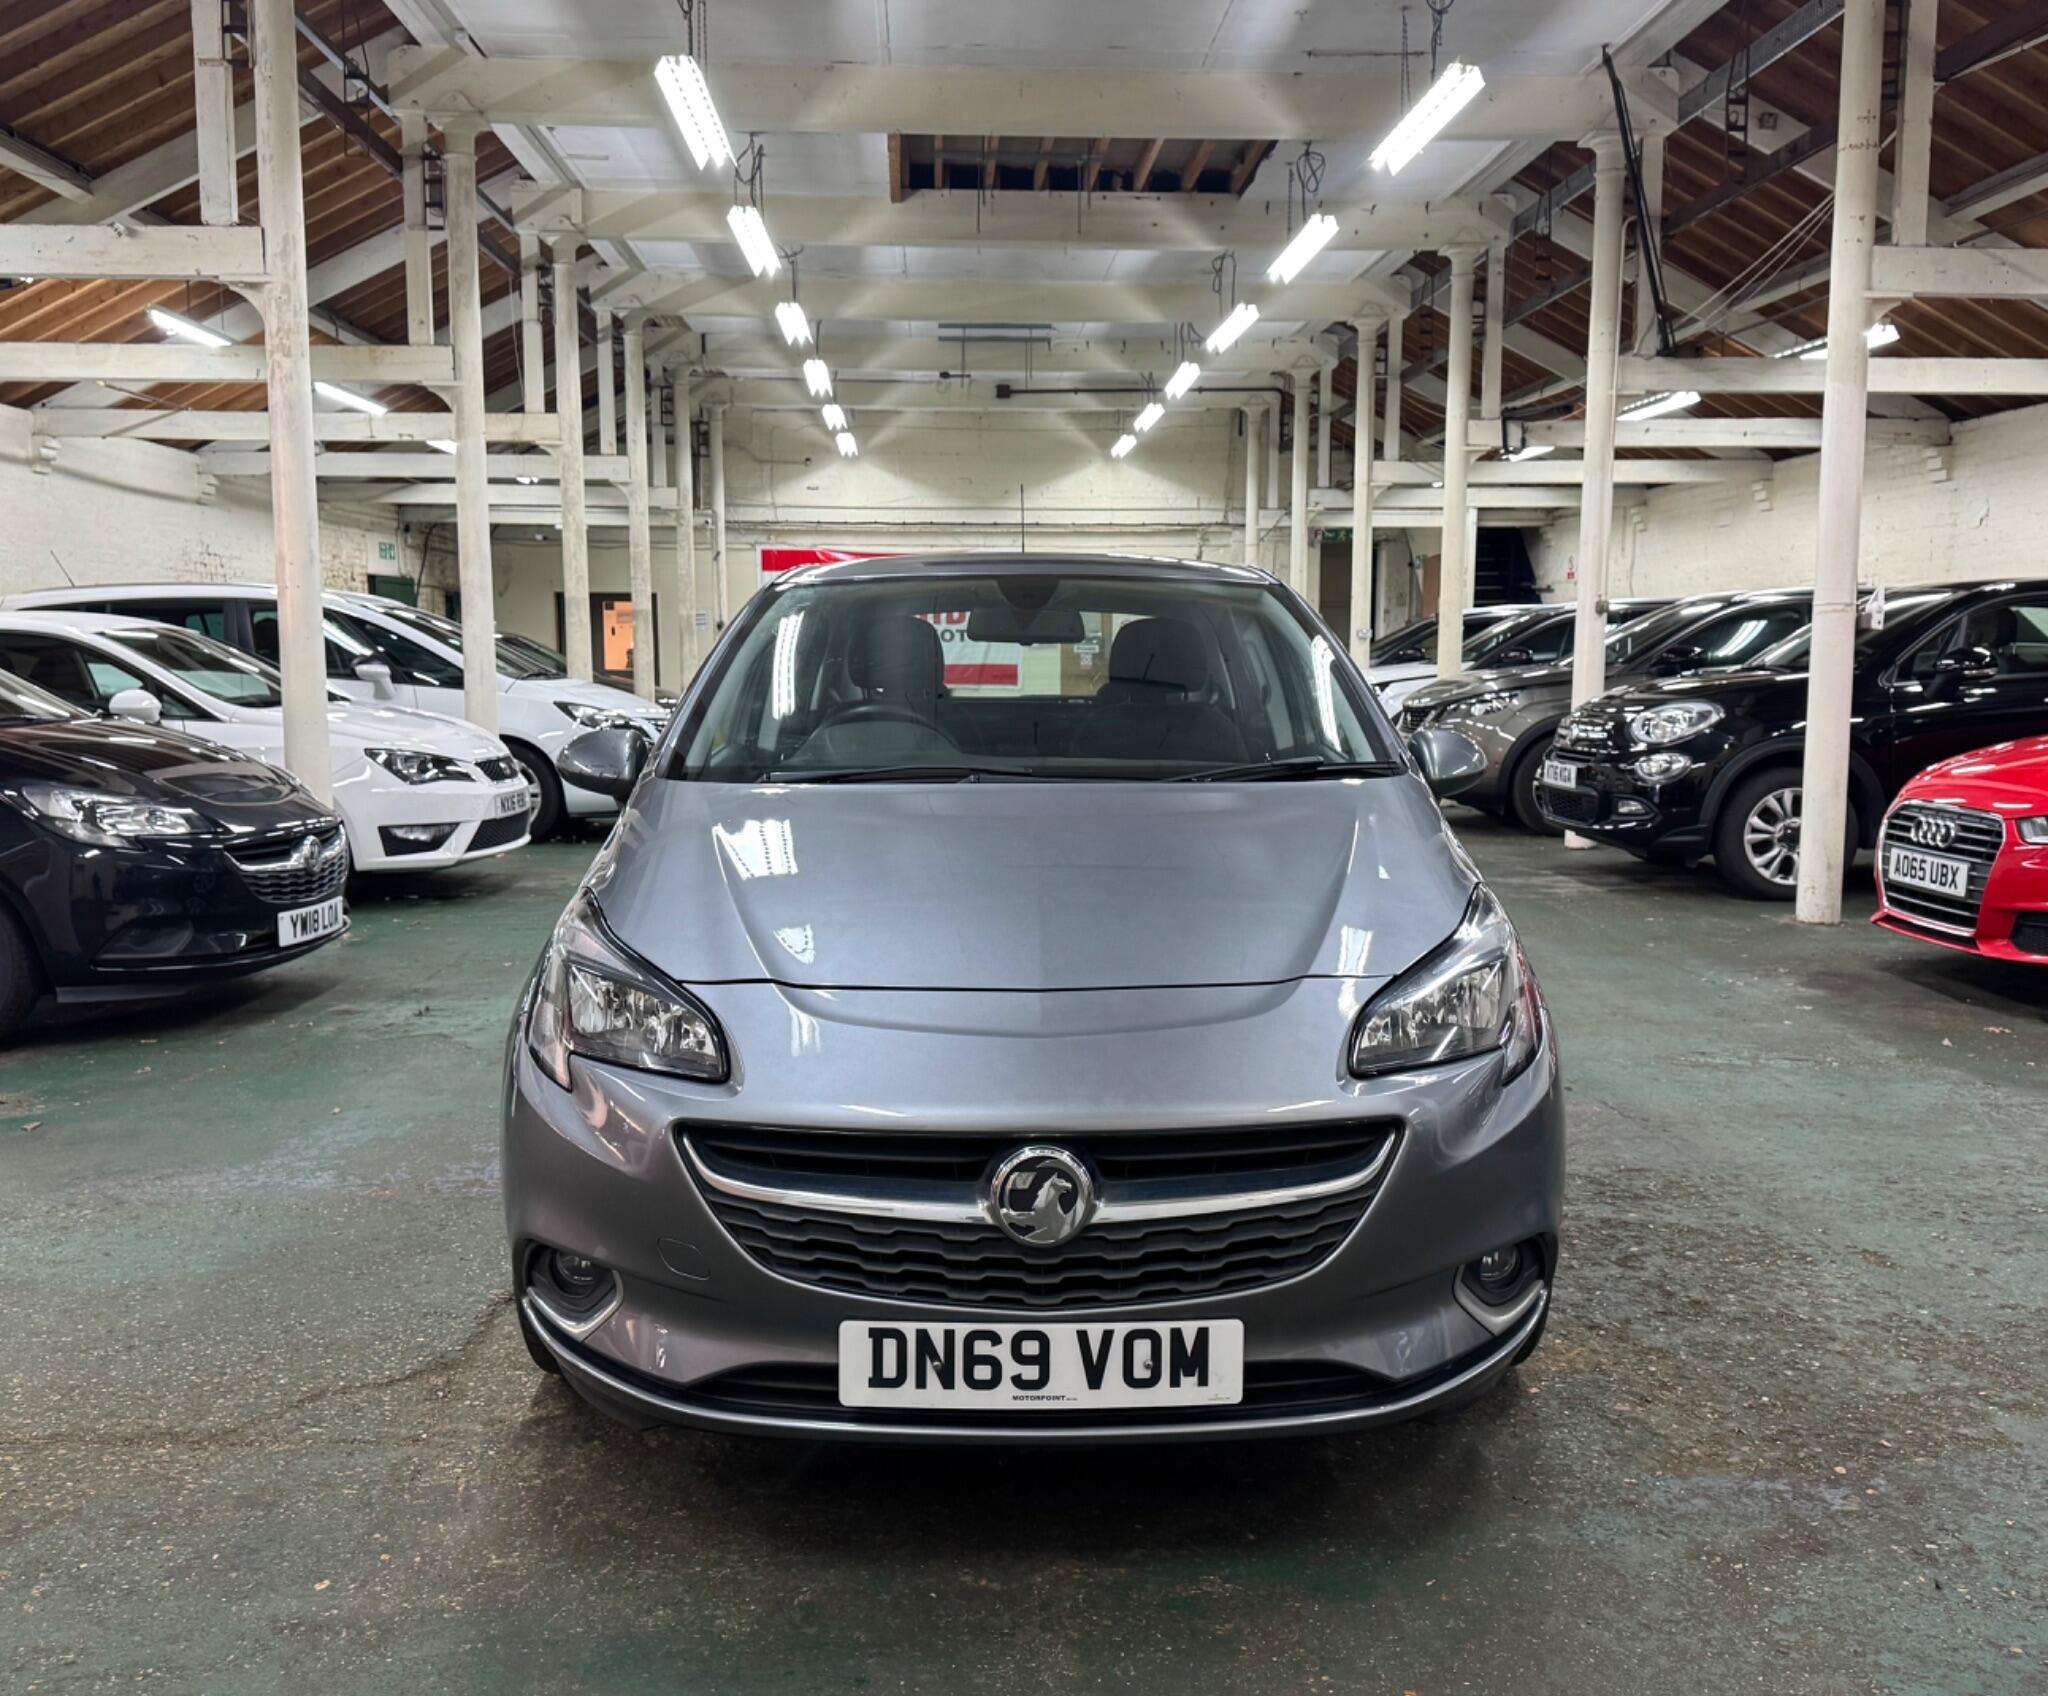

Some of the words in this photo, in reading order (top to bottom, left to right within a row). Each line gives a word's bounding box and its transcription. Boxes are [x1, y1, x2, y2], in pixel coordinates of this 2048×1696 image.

[1930, 860, 1959, 890] UBX
[290, 909, 319, 938] YW18
[868, 1327, 1050, 1390] DN69
[1076, 1327, 1209, 1390] VOM
